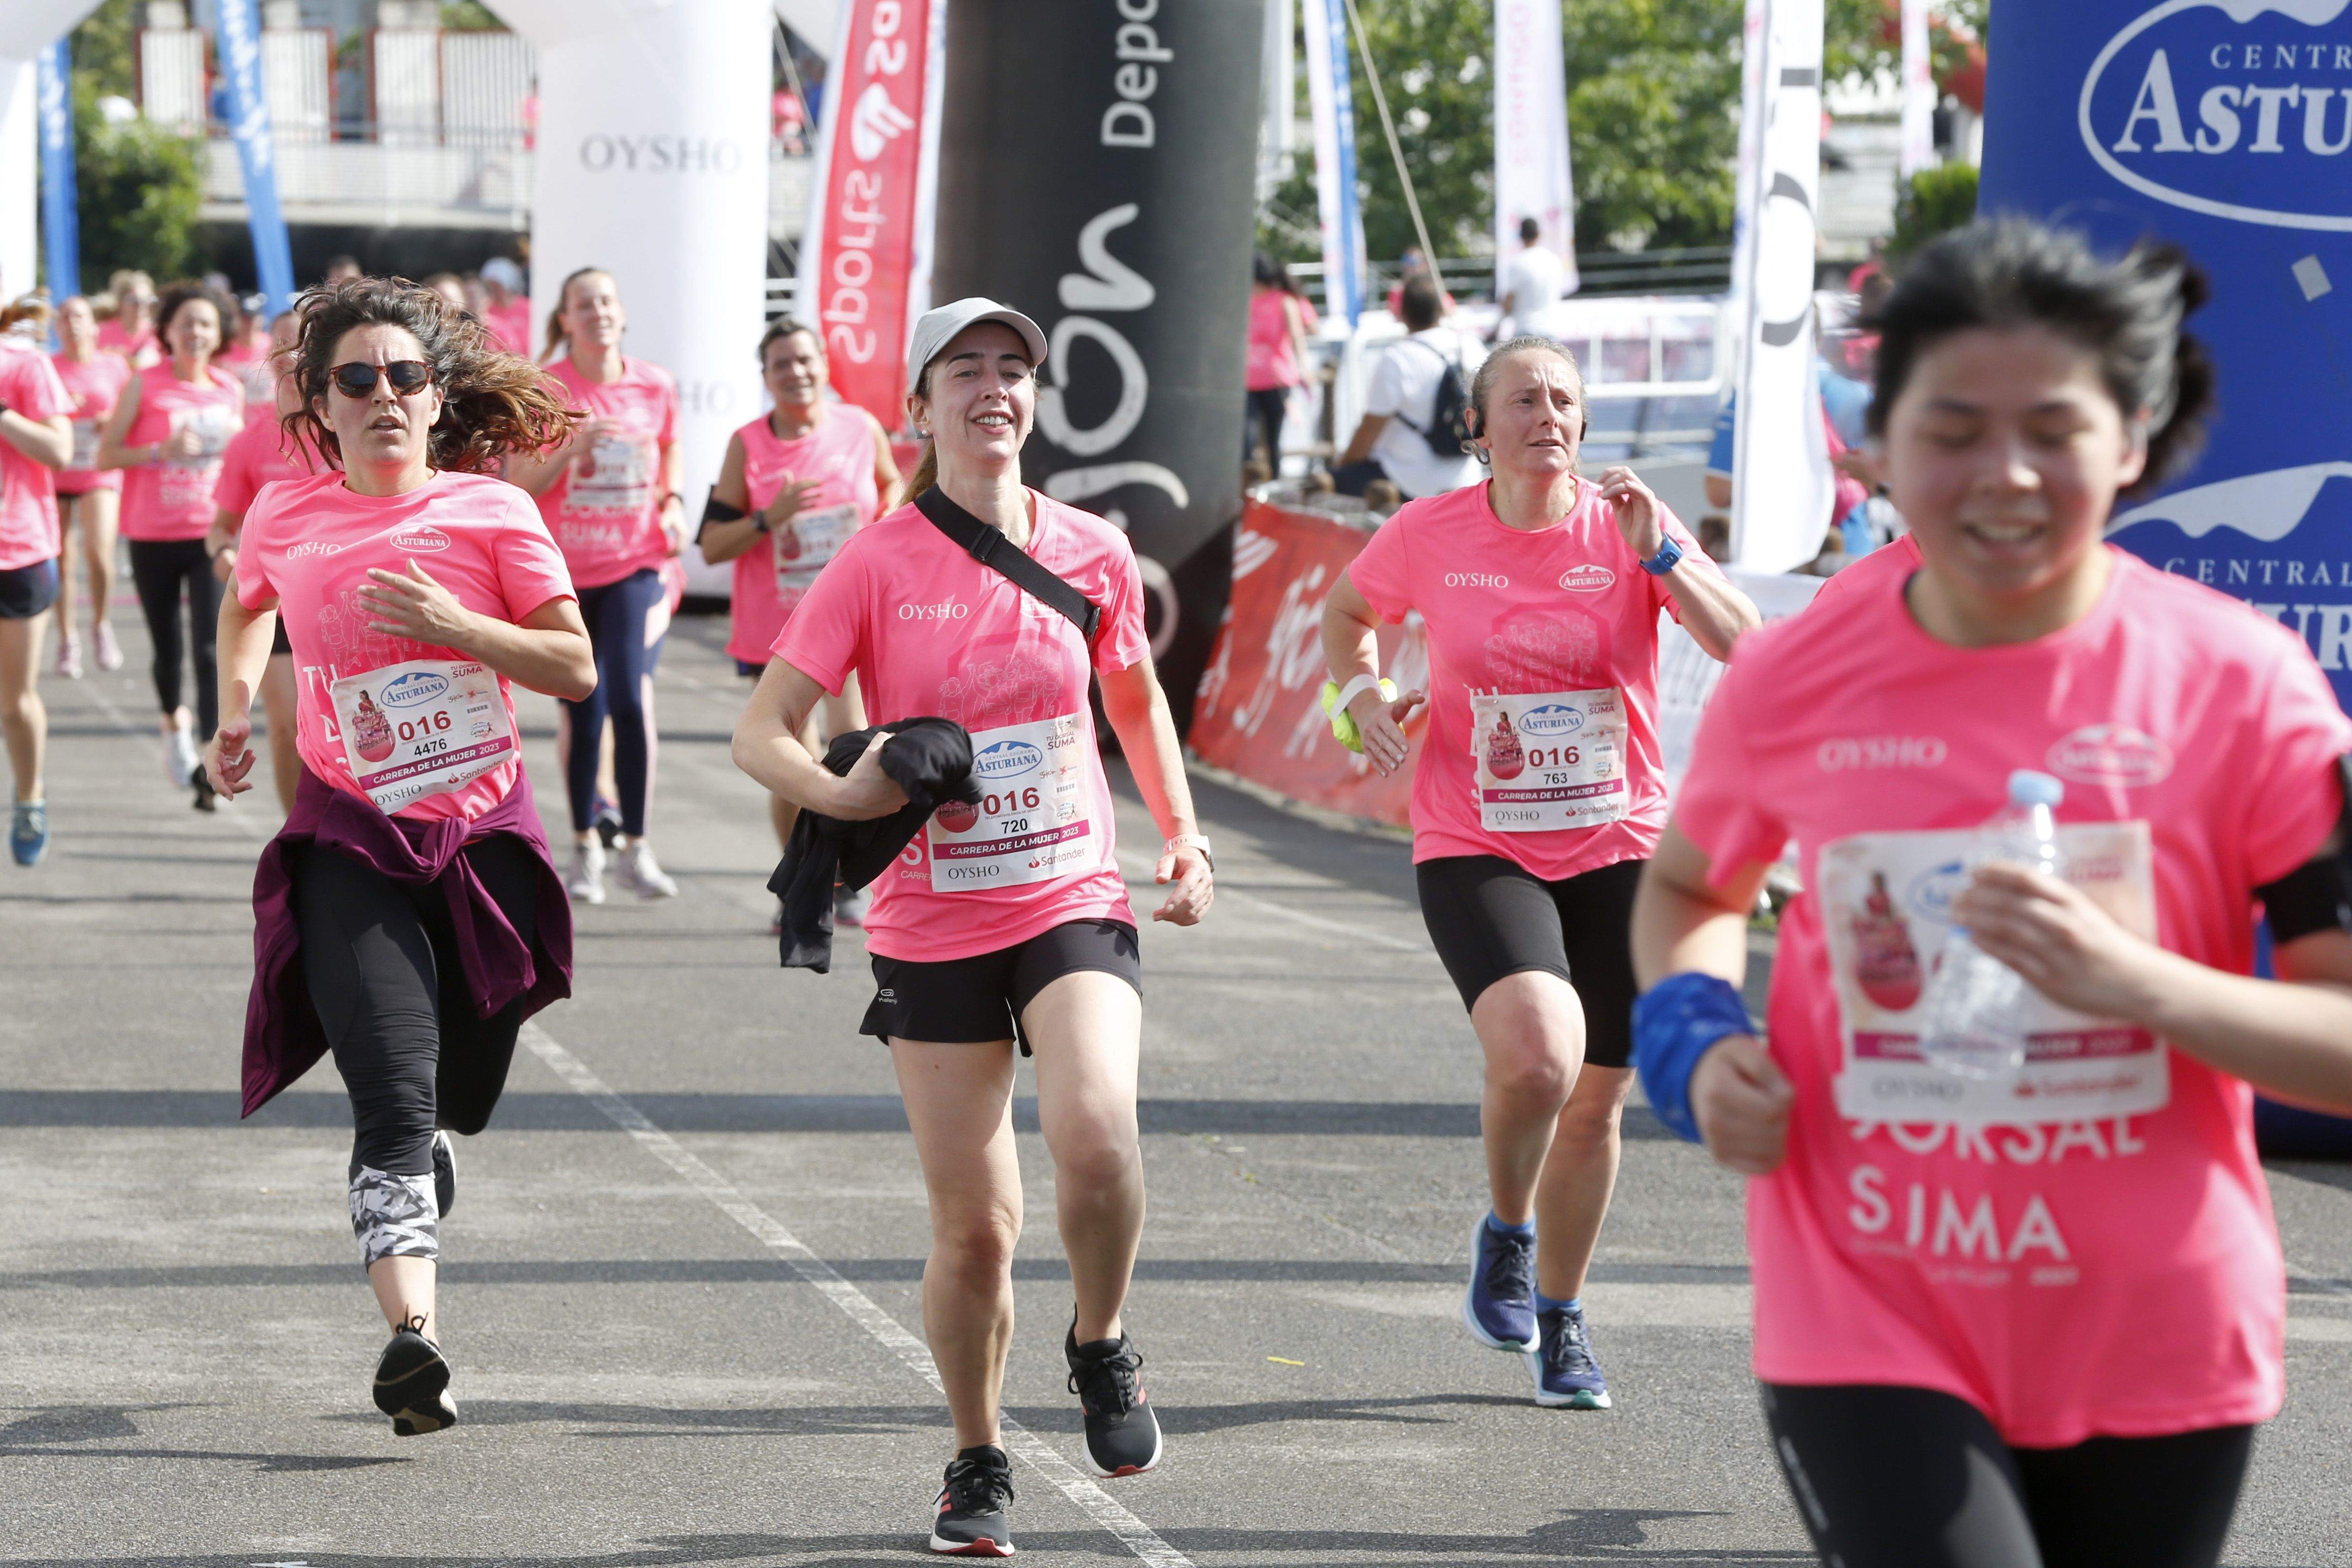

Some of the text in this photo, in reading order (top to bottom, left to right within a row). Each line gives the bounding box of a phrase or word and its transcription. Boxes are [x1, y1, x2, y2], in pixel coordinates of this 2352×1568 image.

[2210, 42, 2352, 70] CENTR
[2112, 48, 2352, 156] ASTU
[579, 133, 742, 174] OYSHO
[395, 534, 446, 547] ASTURIANA
[287, 542, 341, 560] OYSHO
[1445, 572, 1509, 588] OYSHO
[1563, 576, 1610, 587] ASTURIANA
[899, 604, 968, 620] OYSHO
[452, 666, 483, 678] SUMA
[387, 682, 445, 704] ASTURIANA
[1588, 705, 1615, 715] SUMA
[398, 710, 451, 741] 016
[1524, 718, 1580, 729] ASTURIANA
[1047, 736, 1076, 750] SUMA
[1055, 731, 1075, 740] DORSAL
[414, 738, 447, 756] 4476
[373, 743, 500, 784] CARRERA DE LA MUJER 2023
[975, 754, 1038, 774] ASTURIANA
[985, 752, 1009, 761] CENTRAL
[1529, 746, 1580, 767] 016
[375, 759, 504, 805] OYSHO Santander
[1543, 772, 1568, 784] 763
[1567, 787, 1595, 797] MUJER
[1598, 783, 1614, 793] 2023
[983, 787, 1040, 815] 016
[1495, 803, 1618, 821] OYSHO Santander
[1001, 818, 1028, 834] 720
[950, 826, 1079, 855] CARRERA DE LA MUJER 2023
[948, 847, 1086, 880] OYSHO Santander
[901, 870, 932, 881] CARRE
